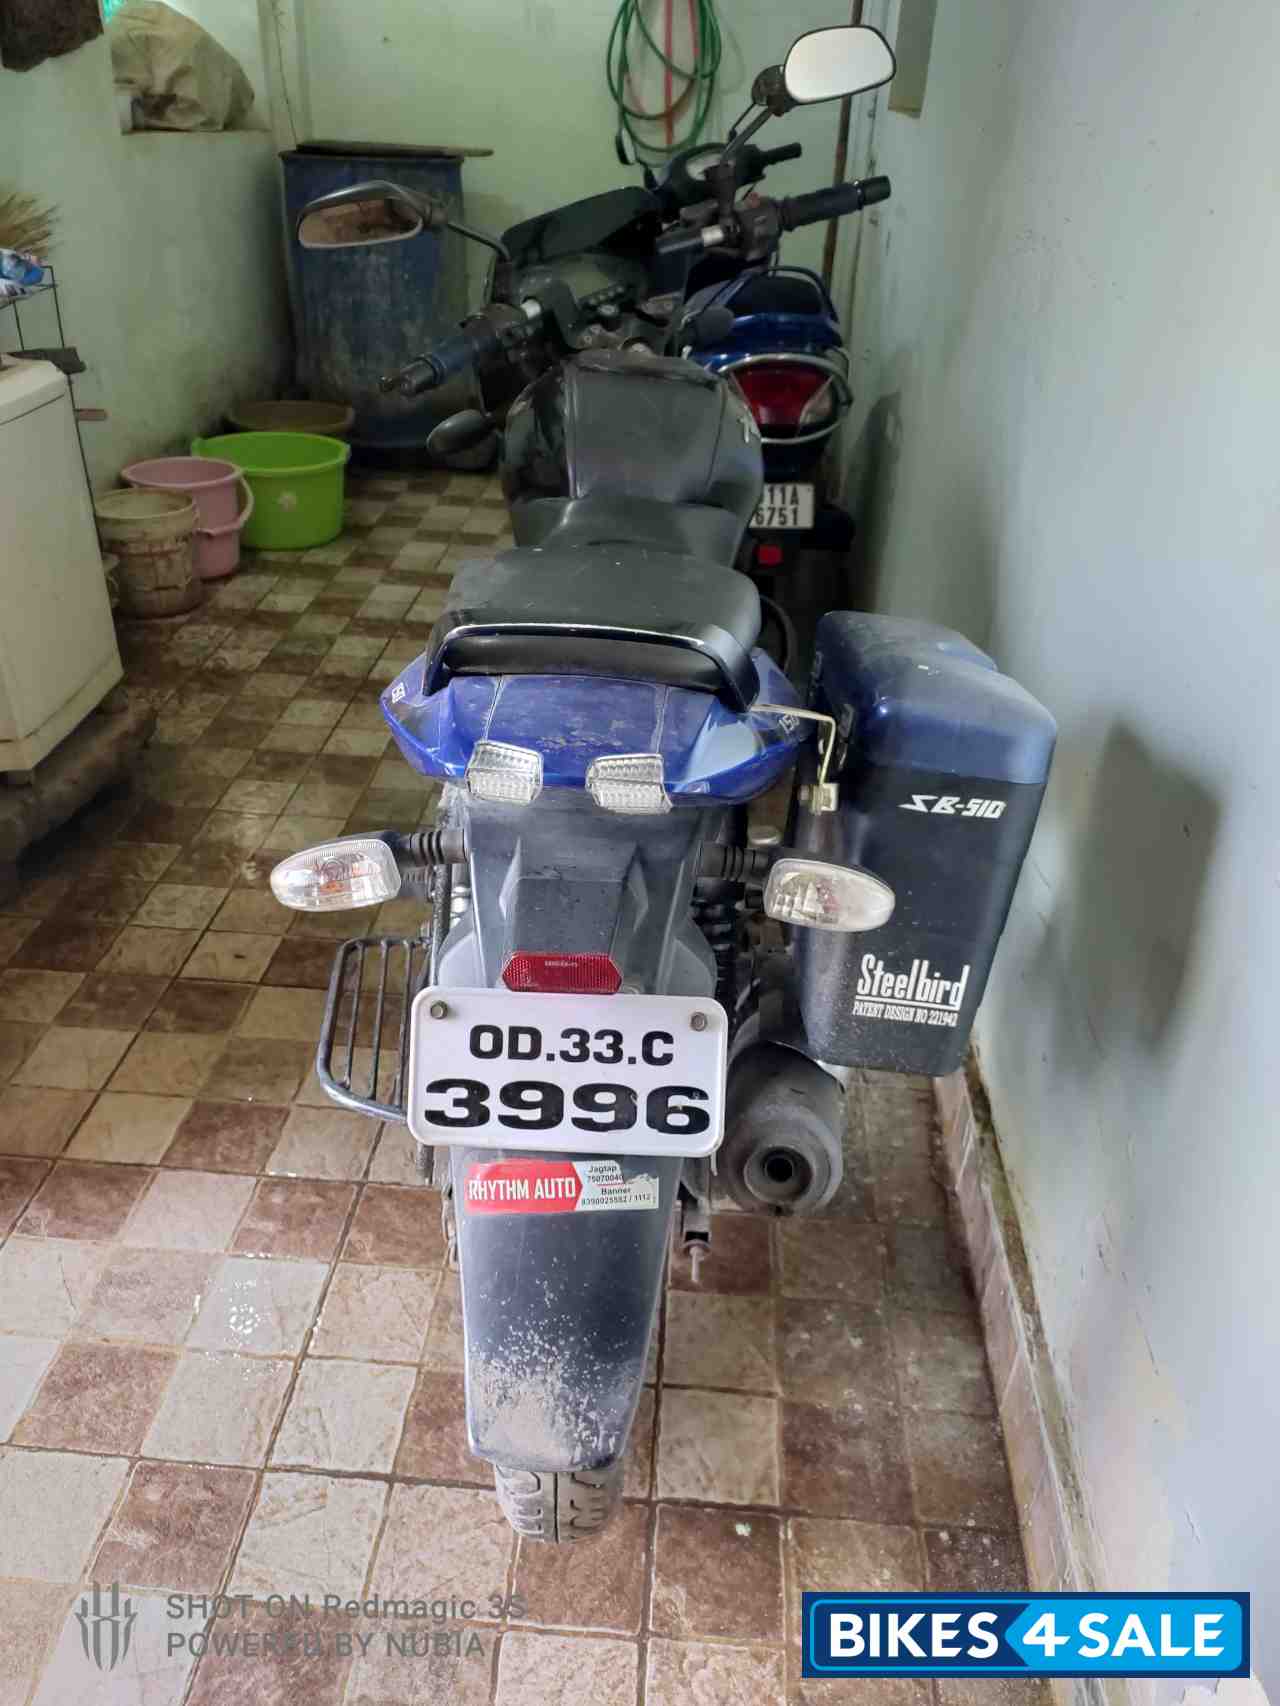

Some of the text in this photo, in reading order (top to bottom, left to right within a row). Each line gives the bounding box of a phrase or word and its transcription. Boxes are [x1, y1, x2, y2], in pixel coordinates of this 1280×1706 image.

[755, 507, 798, 526] 6751
[857, 954, 970, 1008] Steelbird
[852, 1000, 885, 1019] PATENT
[469, 1024, 674, 1066] OD.33.C
[424, 1078, 711, 1135] 3996
[468, 1177, 576, 1201] RHYTHM AUTO
